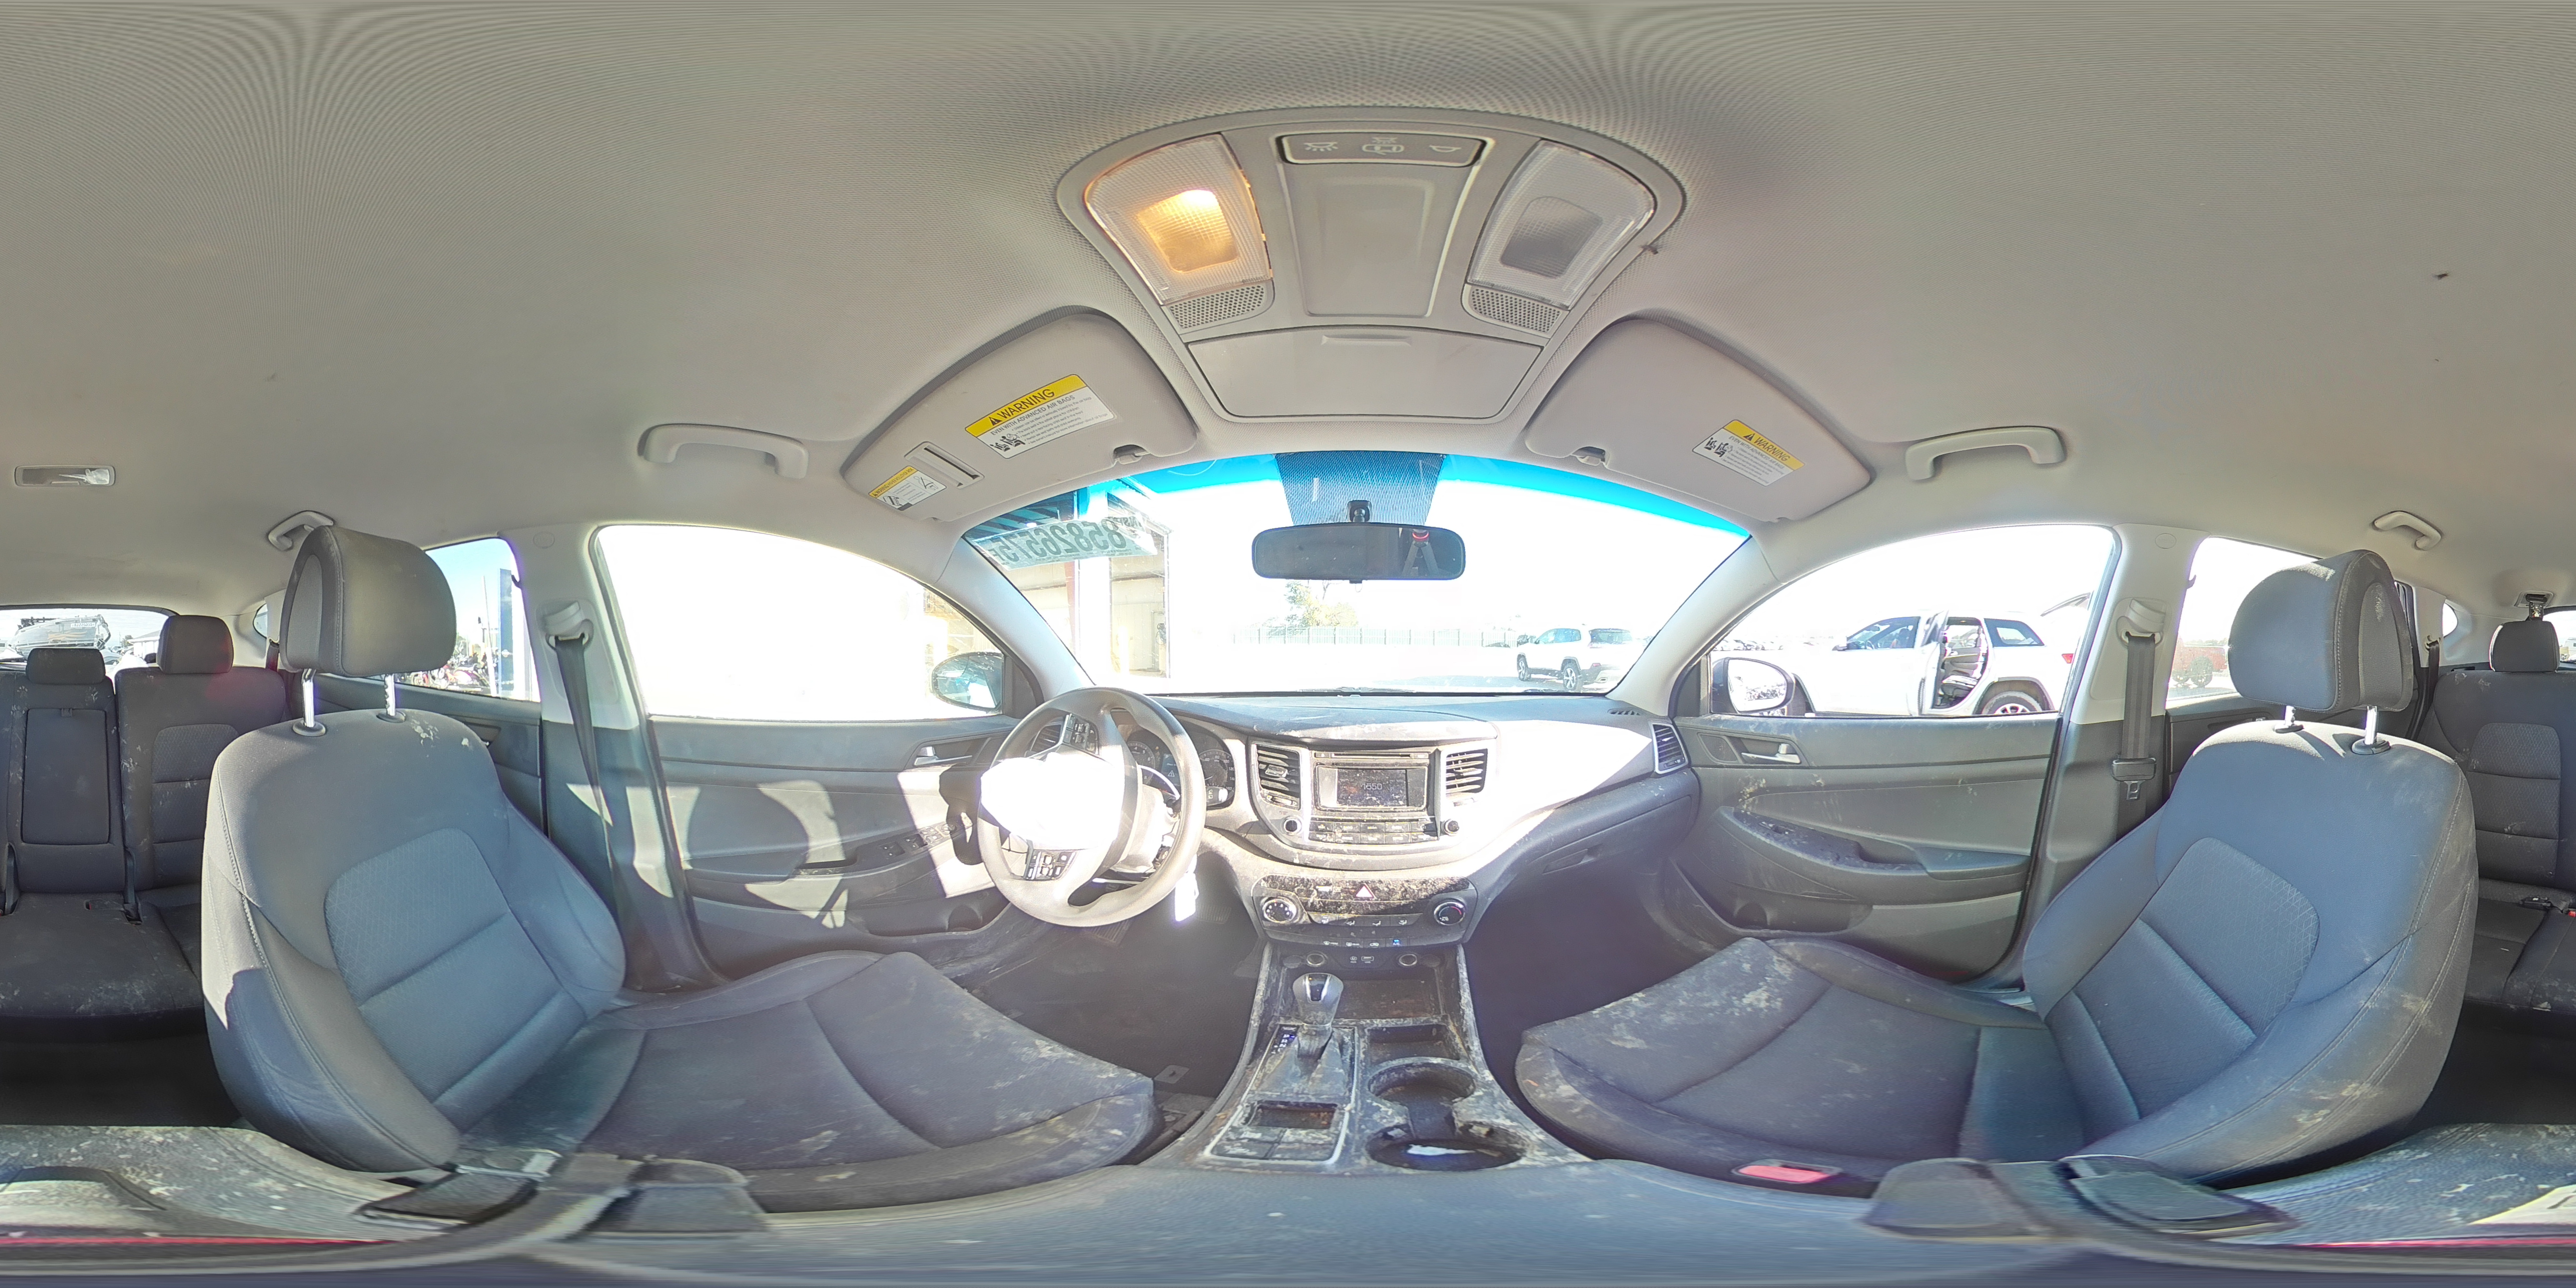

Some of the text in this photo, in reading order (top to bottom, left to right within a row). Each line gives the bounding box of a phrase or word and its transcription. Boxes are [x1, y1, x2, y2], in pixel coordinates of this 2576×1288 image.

[990, 427, 1005, 436] EVEN
[1002, 420, 1018, 429] WITH
[1016, 407, 1046, 423] ADVANCED
[1056, 395, 1075, 405] BAGS
[997, 389, 1055, 419] WARNING
[1728, 436, 1741, 444] EVEN
[1740, 441, 1751, 449] WITH
[1750, 448, 1771, 460] ADVANCED
[1754, 437, 1790, 461] WARNING
